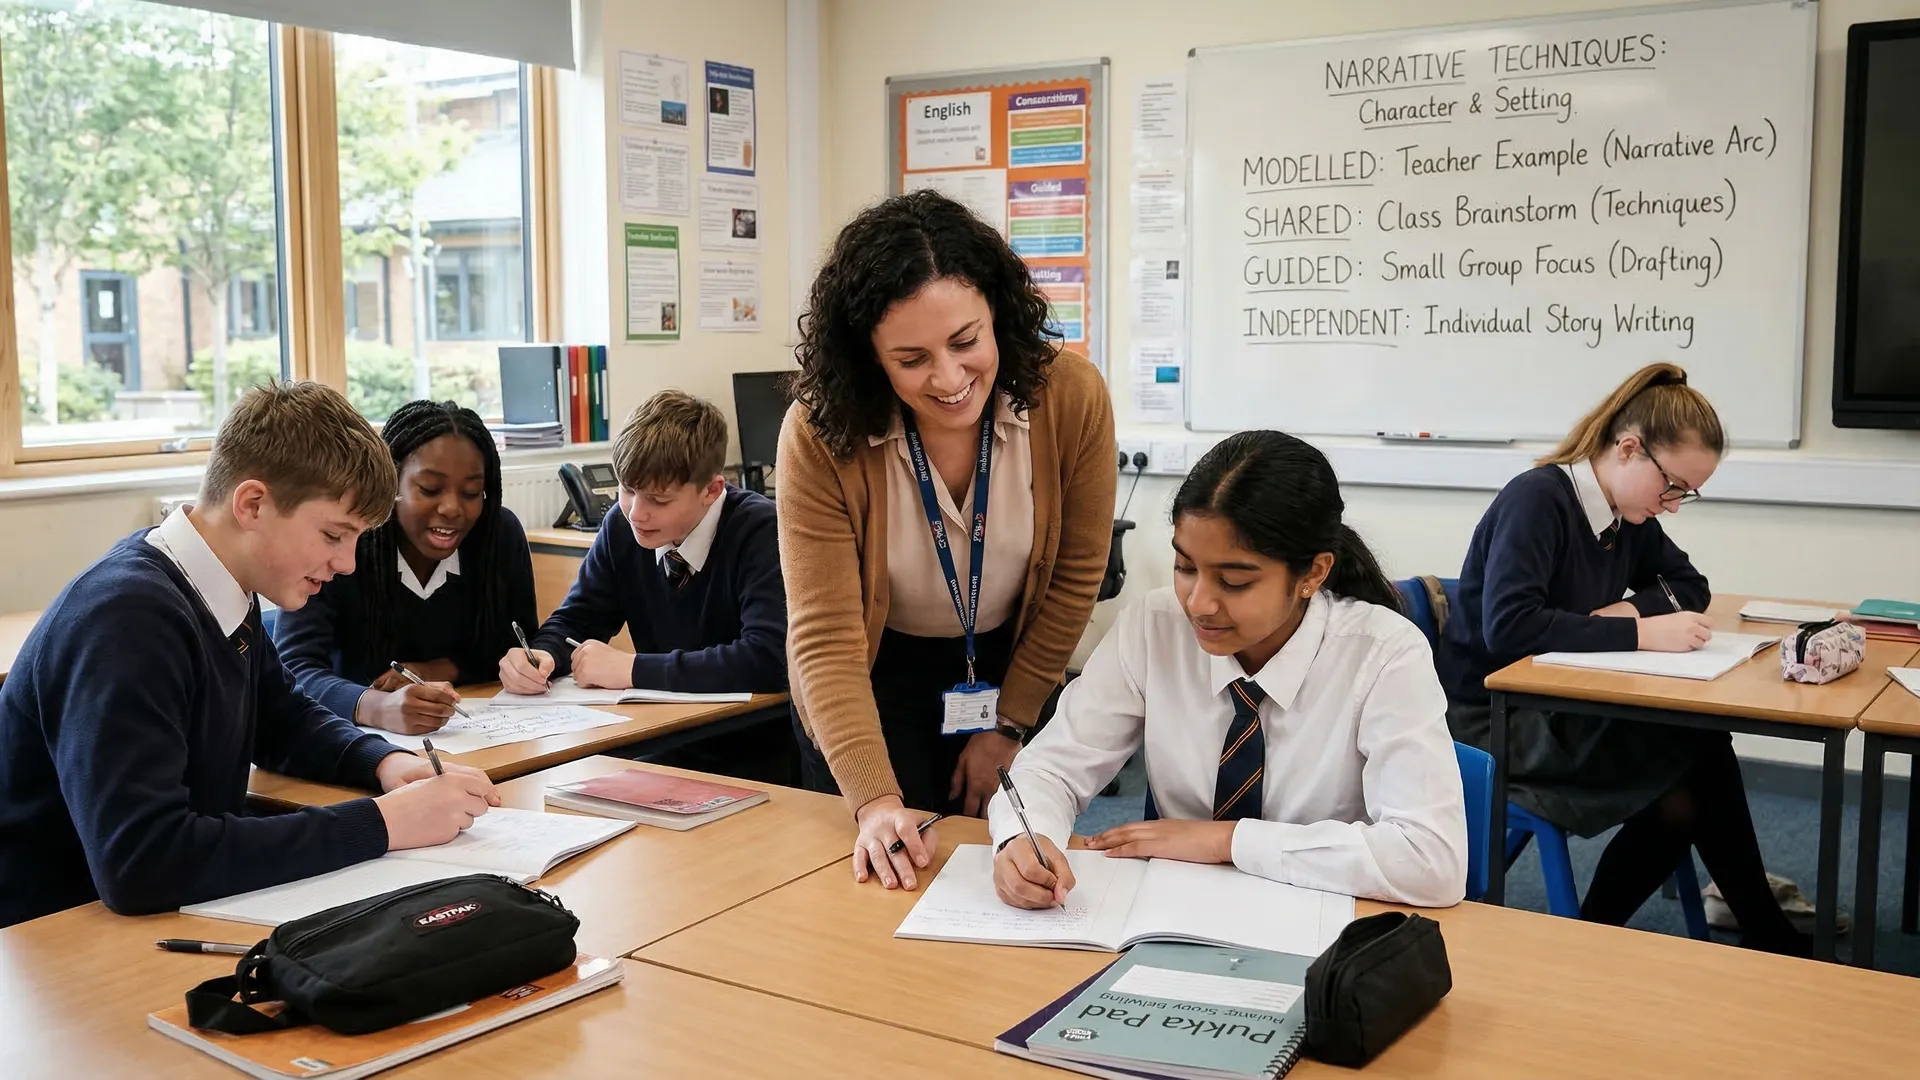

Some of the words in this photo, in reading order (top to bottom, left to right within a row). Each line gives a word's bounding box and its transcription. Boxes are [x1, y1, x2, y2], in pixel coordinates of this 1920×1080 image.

[1326, 51, 1465, 89] NARRATIVE
[1489, 34, 1667, 74] TECHNIQUES:
[924, 102, 971, 120] English
[1360, 97, 1457, 124] Character
[1469, 93, 1483, 114] &
[1244, 151, 1384, 186] MODELLED:
[1396, 145, 1482, 176] Teacher
[1496, 139, 1588, 176] Example
[1603, 129, 1715, 168] (Narrative
[1725, 118, 1777, 158] Arc)
[1244, 204, 1363, 238] SHARED:
[1378, 200, 1442, 231] Class
[1456, 195, 1577, 227] Brainstorm
[1592, 178, 1737, 226] (Techniques)
[1244, 256, 1363, 285] GUIDED:
[1381, 251, 1445, 281] Small
[1459, 249, 1522, 285] Group
[1535, 244, 1595, 274] Focus
[1609, 237, 1723, 287] (Drafting)
[1244, 307, 1410, 336] INDEPENDENT:
[1424, 305, 1531, 335] Individual
[1546, 303, 1602, 348] Story
[1614, 304, 1694, 348] Writing
[418, 903, 477, 925] EASTPAK
[1077, 1004, 1150, 1029] Pad
[1161, 1015, 1277, 1045] Pukka
